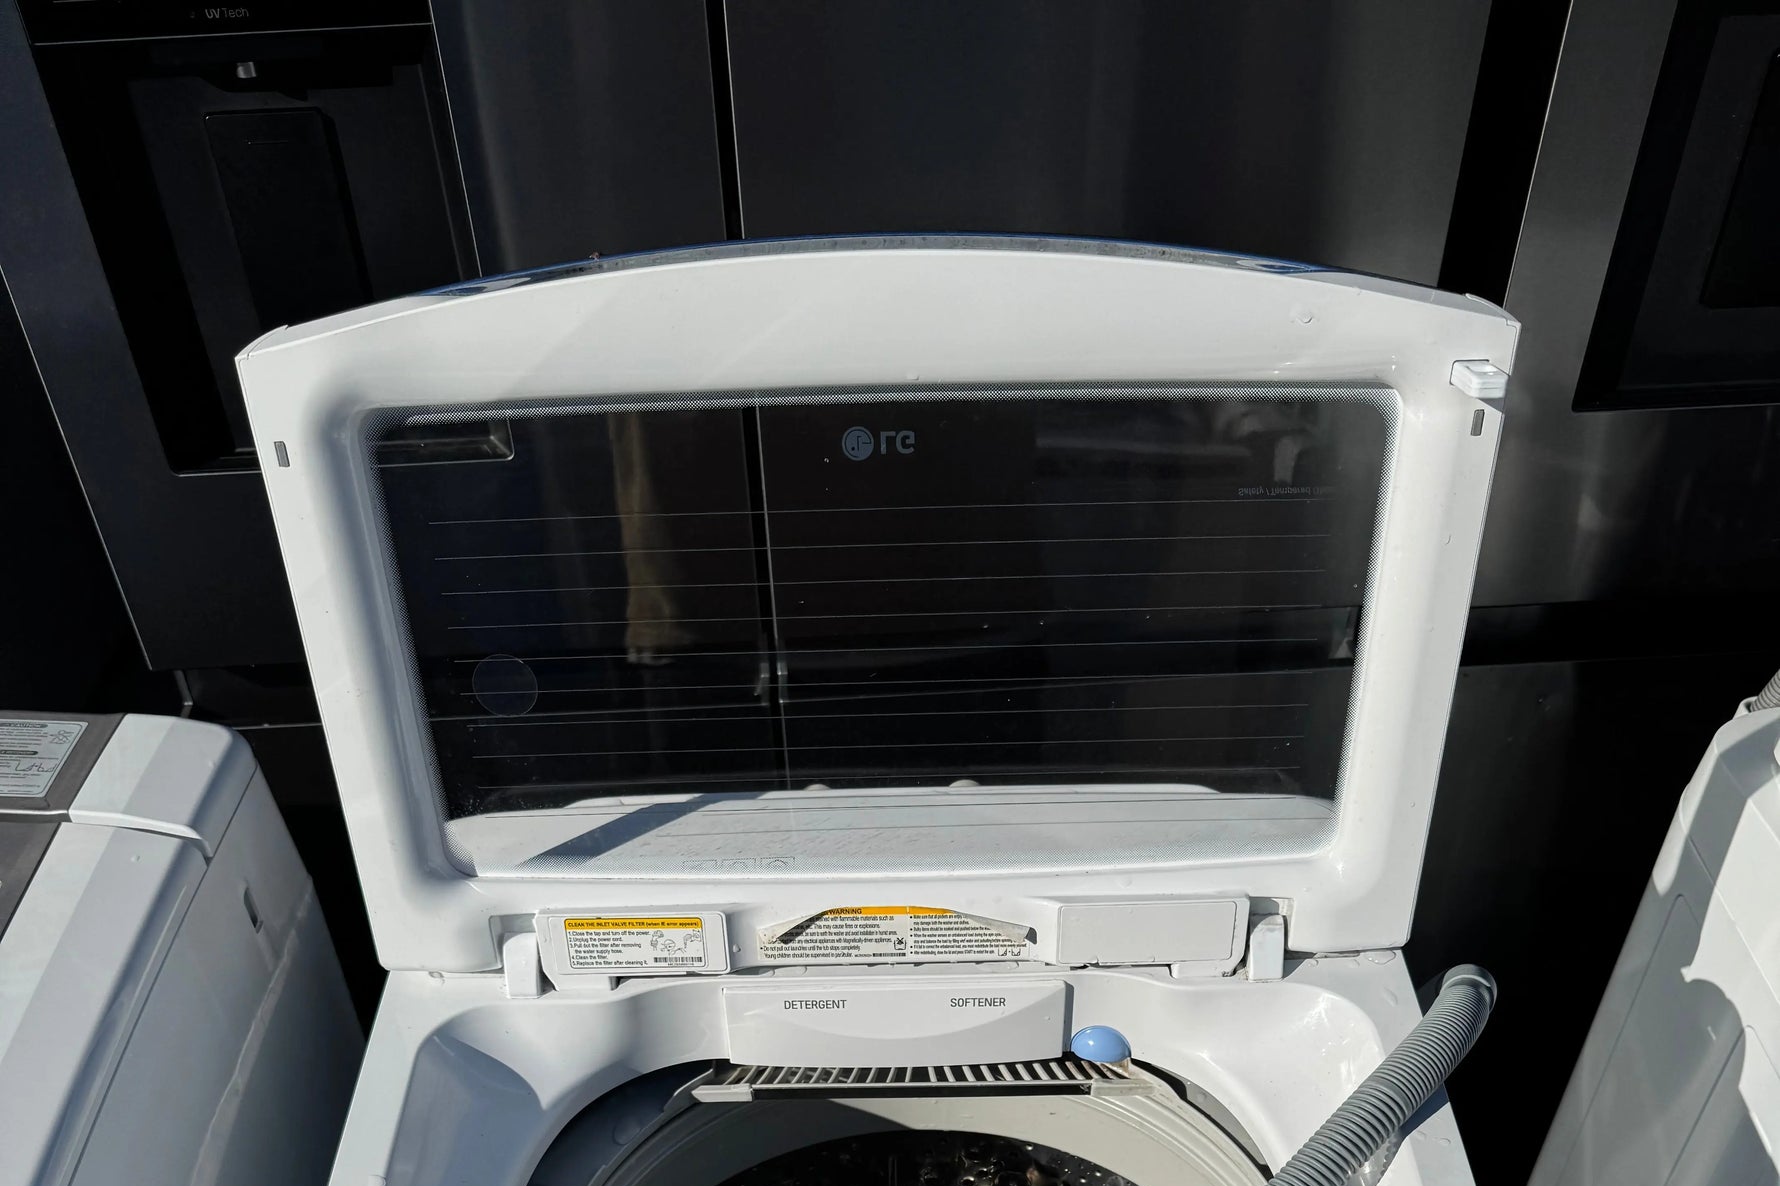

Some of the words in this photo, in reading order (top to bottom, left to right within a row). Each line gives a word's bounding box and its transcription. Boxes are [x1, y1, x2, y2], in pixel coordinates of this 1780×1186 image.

[205, 8, 220, 19] UV
[221, 7, 249, 18] Tech
[784, 999, 847, 1010] DETERGENT
[950, 997, 1006, 1008] SOFTENER
